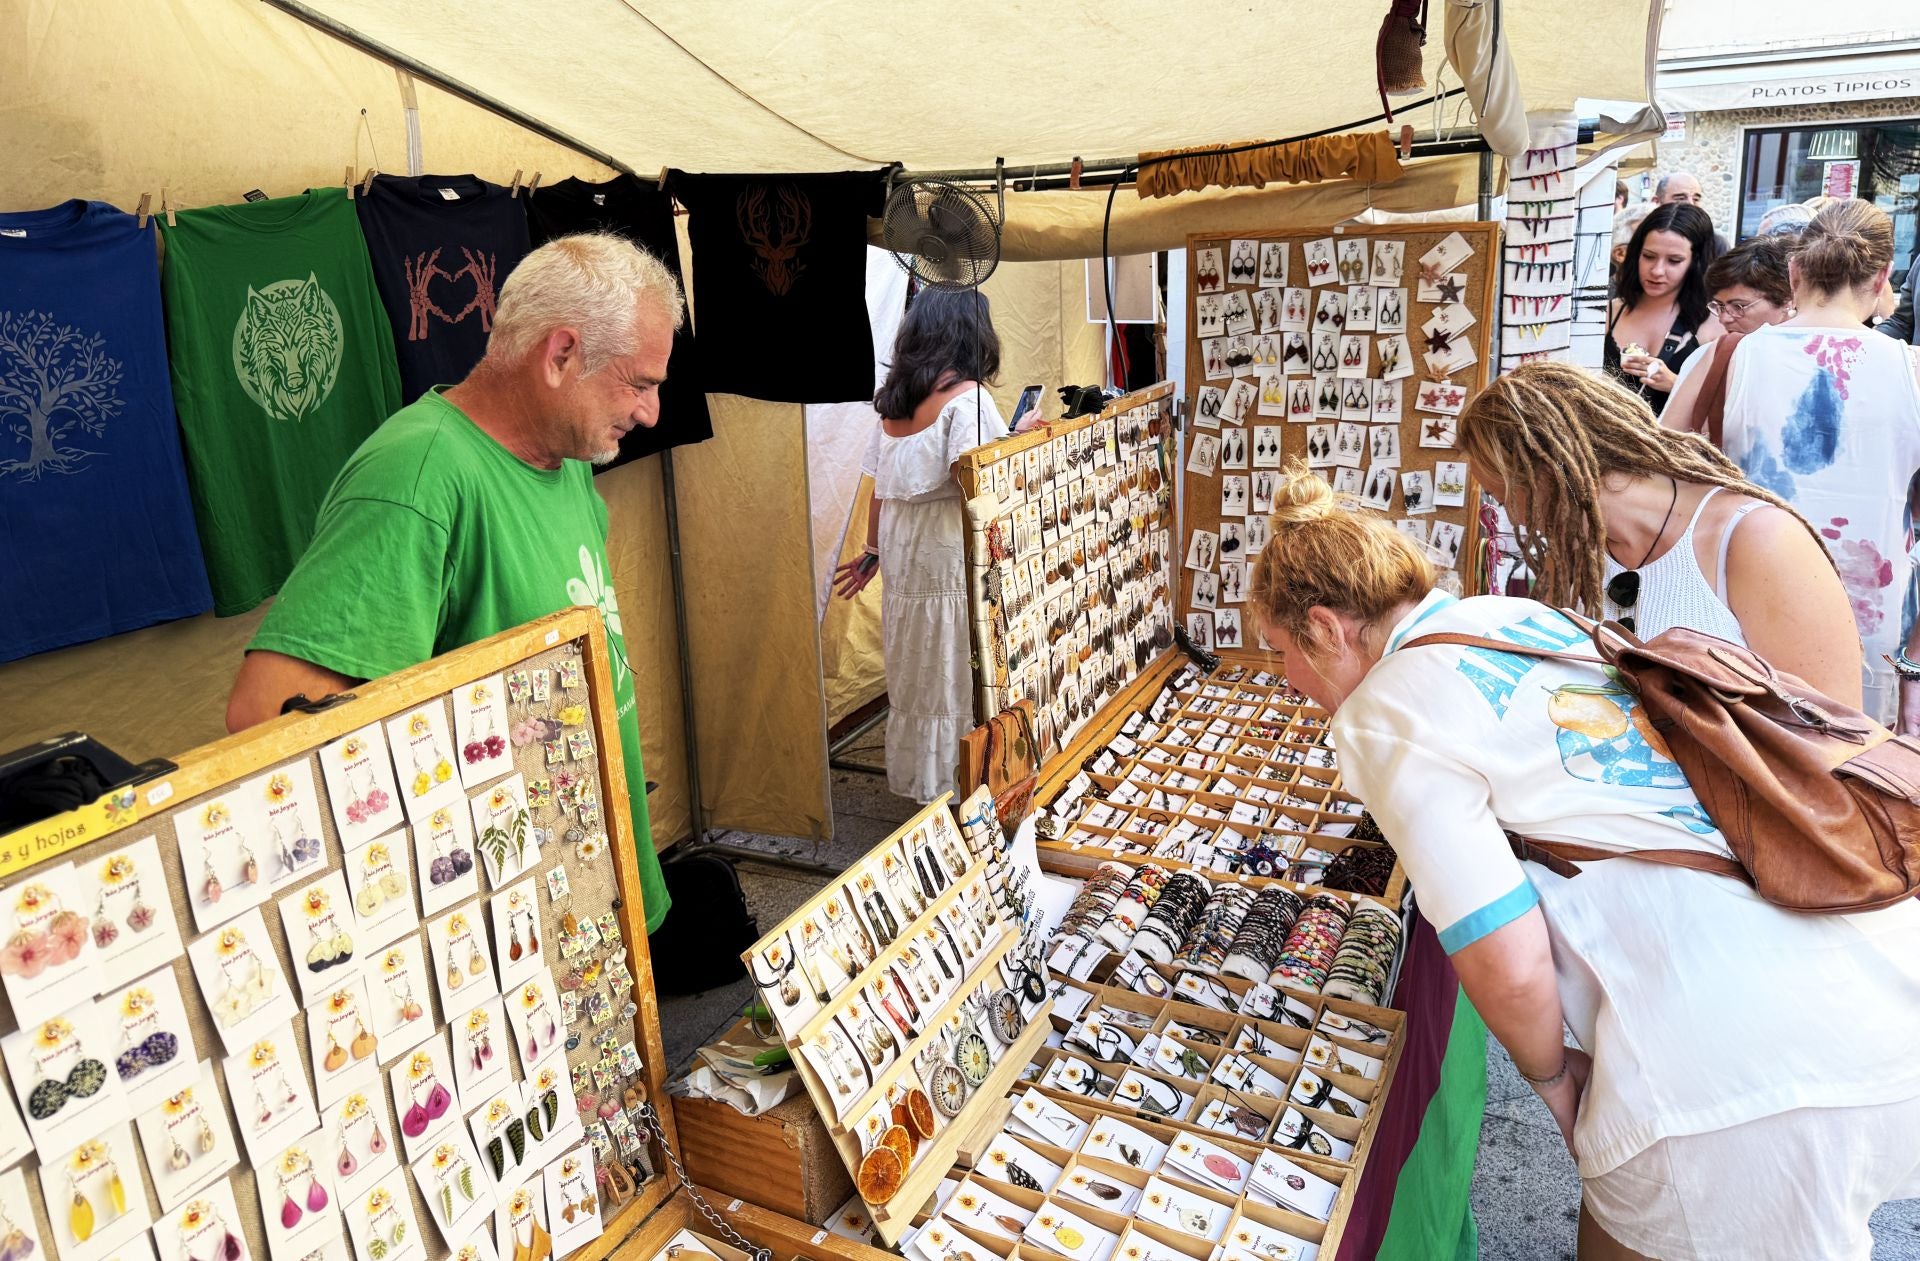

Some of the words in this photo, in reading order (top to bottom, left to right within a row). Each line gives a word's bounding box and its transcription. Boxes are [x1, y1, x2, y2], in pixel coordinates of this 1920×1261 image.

[1752, 85, 1827, 98] PLATOS
[1834, 78, 1911, 92] TIPICOS
[18, 844, 29, 860] y
[35, 823, 87, 850] hojas
